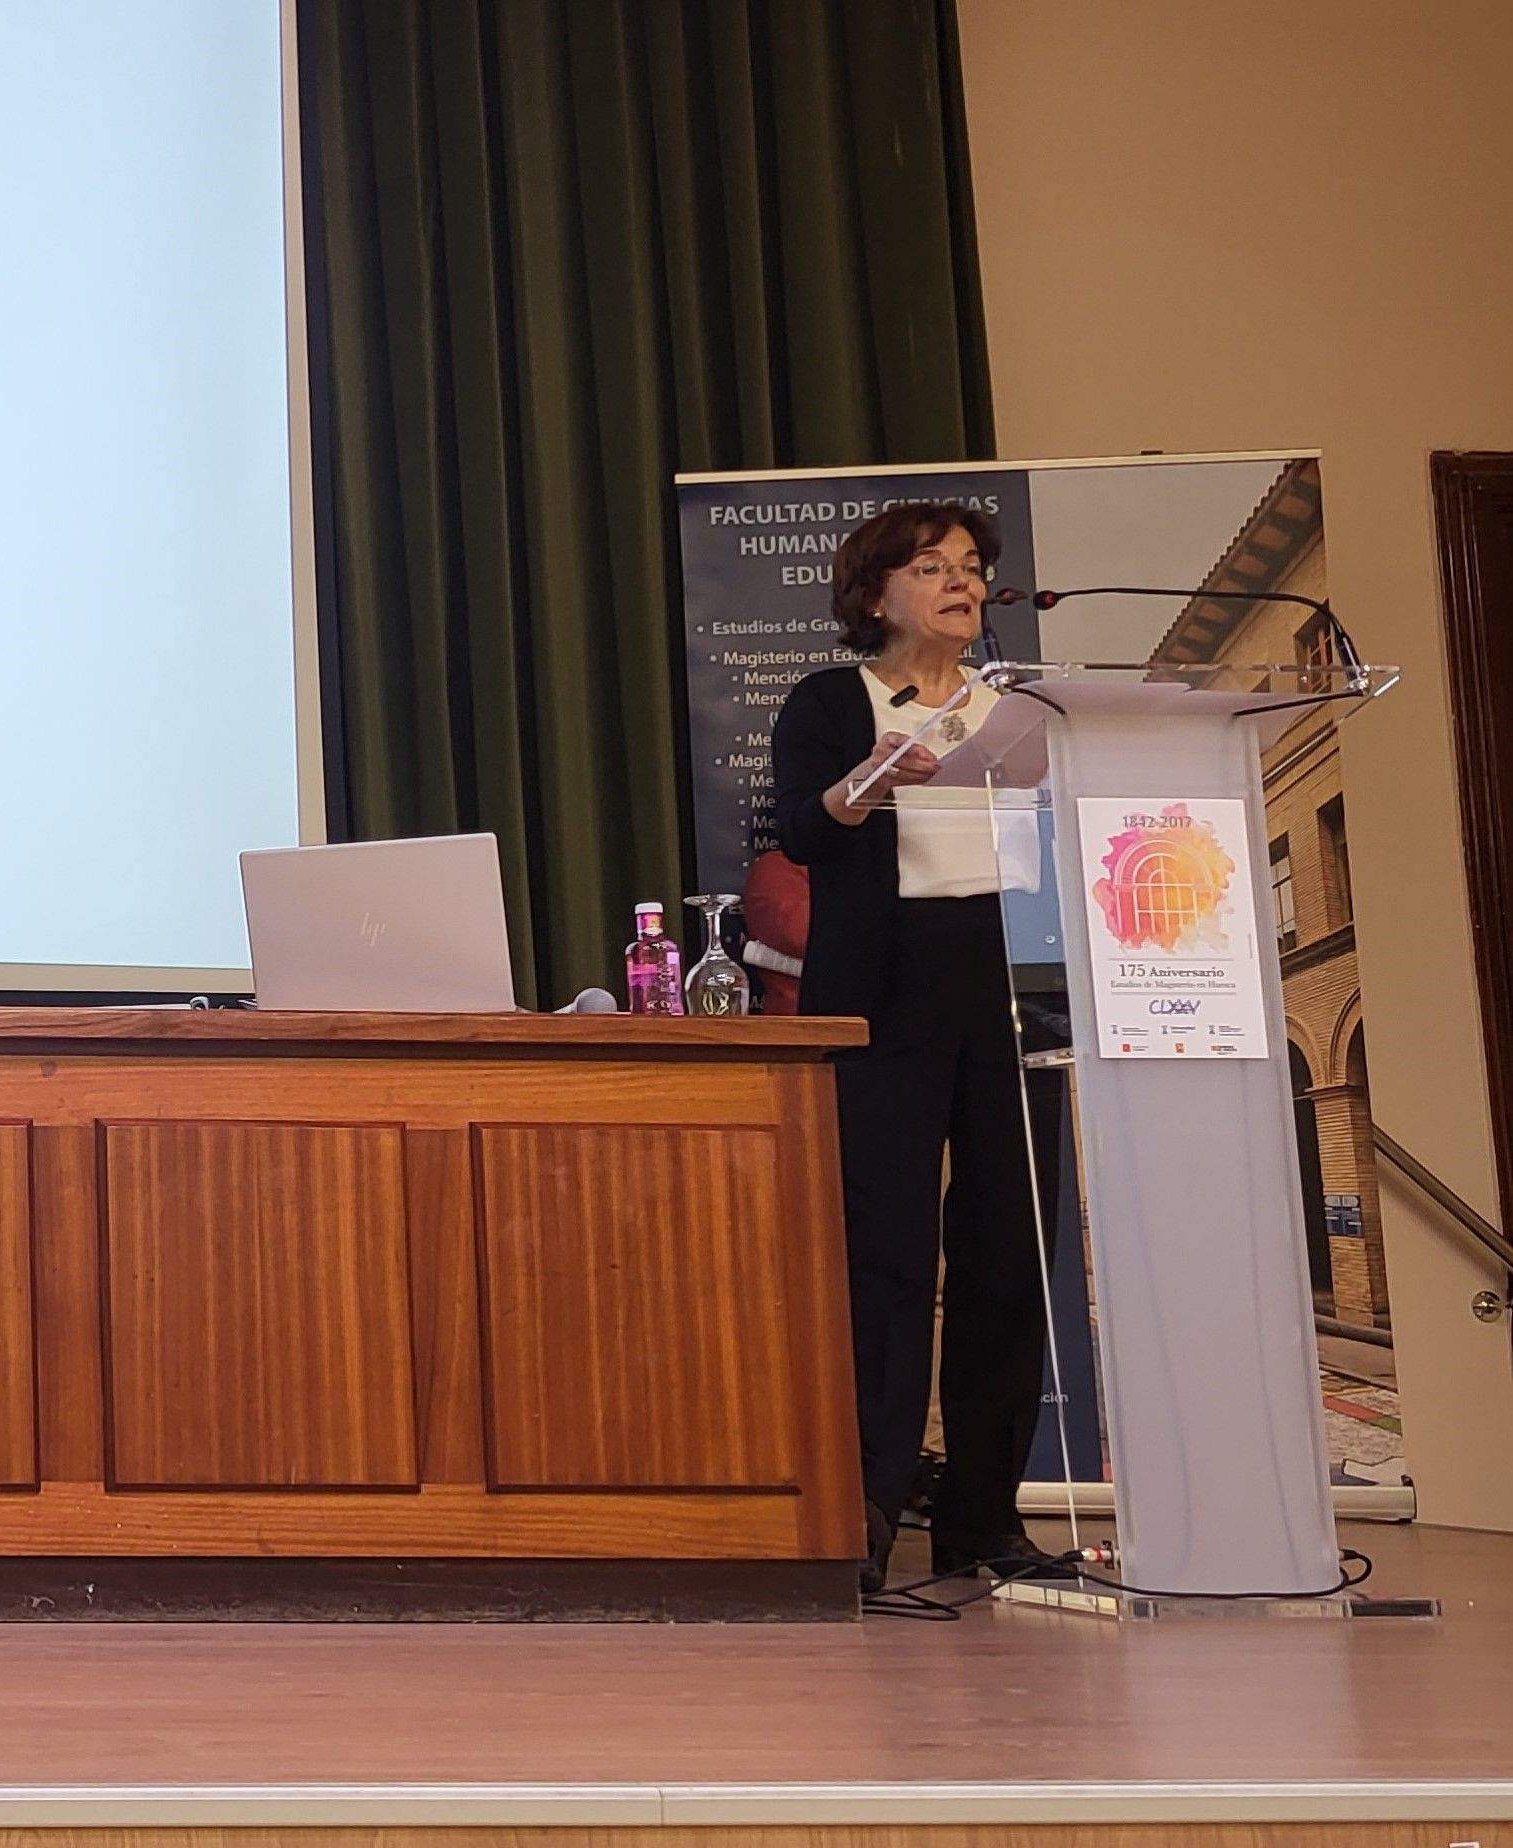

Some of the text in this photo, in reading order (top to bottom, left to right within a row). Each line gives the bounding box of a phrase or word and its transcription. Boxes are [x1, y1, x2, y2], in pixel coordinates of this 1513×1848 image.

[709, 503, 836, 525] FACULTAD
[842, 500, 877, 520] DE
[782, 564, 834, 586] EDU
[712, 618, 840, 635] Estudios de Gra
[723, 650, 806, 668] Magisterio
[808, 652, 829, 663] en
[744, 691, 788, 706] Menc
[1119, 963, 1225, 978] 175 Aniversario
